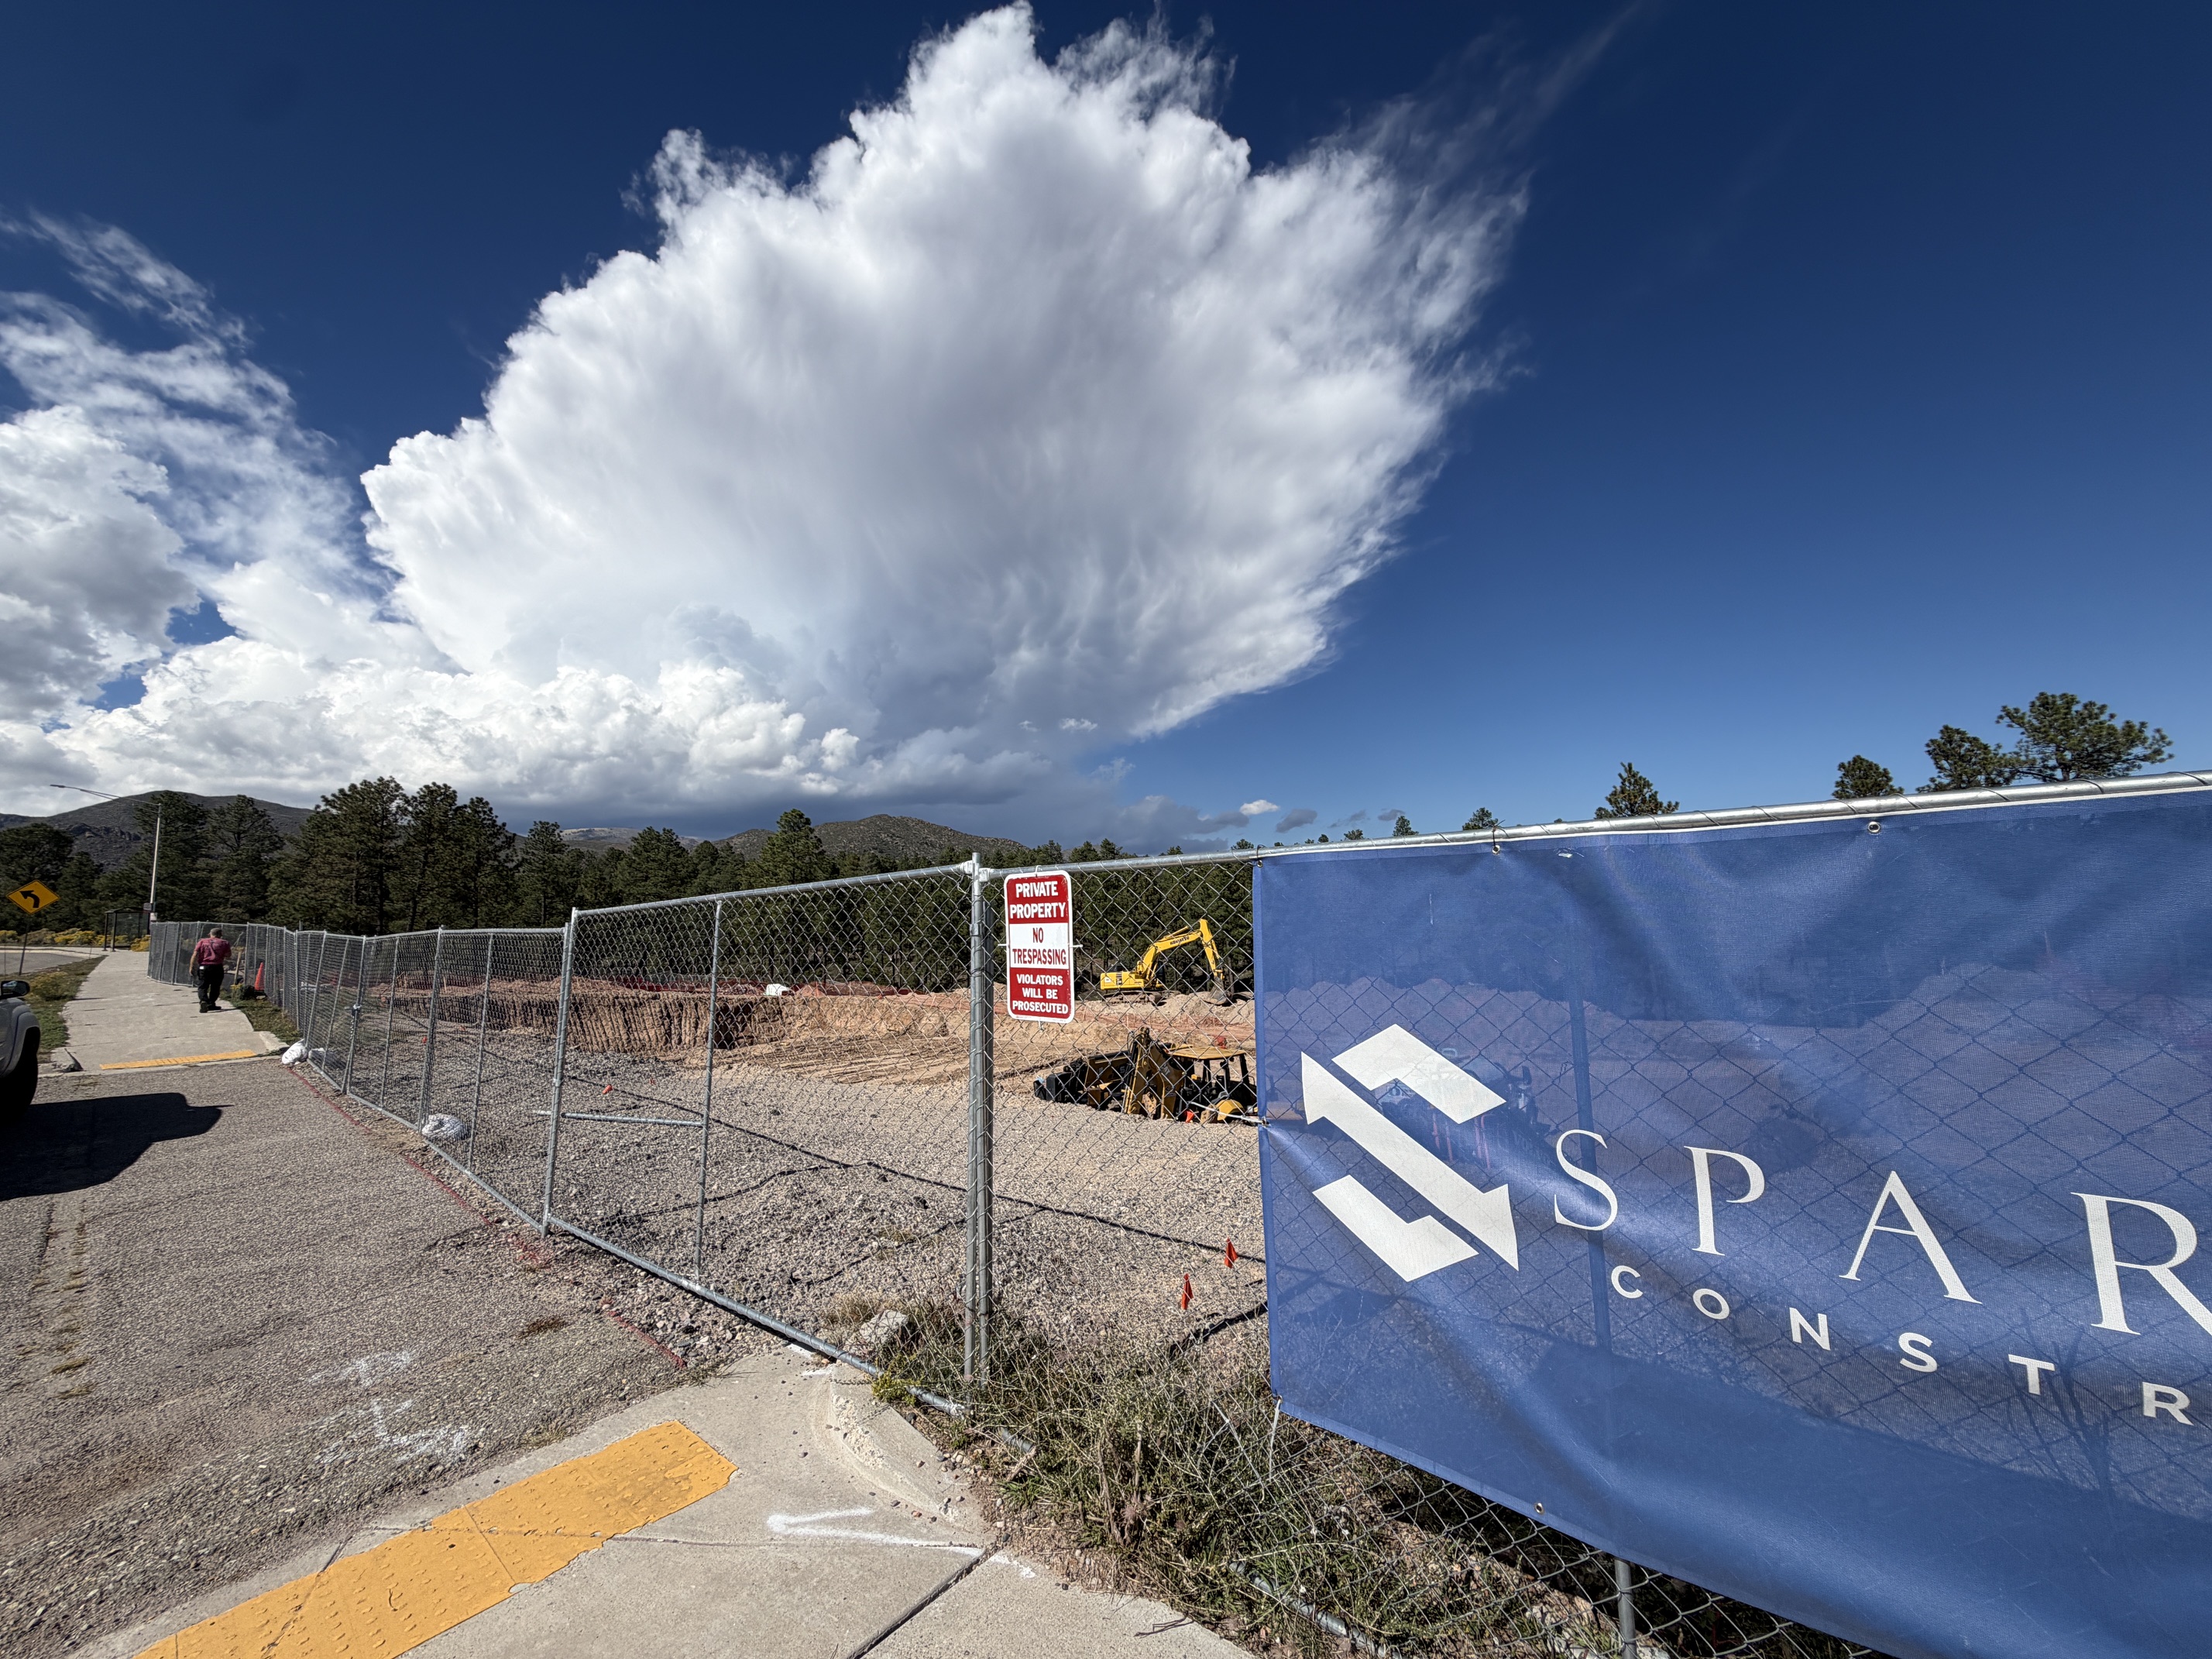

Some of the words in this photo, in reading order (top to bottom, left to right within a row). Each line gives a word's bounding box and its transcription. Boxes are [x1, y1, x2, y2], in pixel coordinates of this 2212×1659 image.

[1015, 881, 1059, 898] PRIVATE
[1009, 902, 1066, 919] PROPERTY
[1032, 927, 1044, 943] NO
[1012, 948, 1067, 966] TRESPASSING
[1016, 974, 1063, 986] VIOLATORS
[1022, 988, 1043, 998] WILL
[1046, 988, 1058, 1000] BE
[1012, 1001, 1069, 1015] PROSECUTED
[1554, 1128, 2212, 1336] SPAR
[1611, 1266, 2195, 1427] CONSTR
